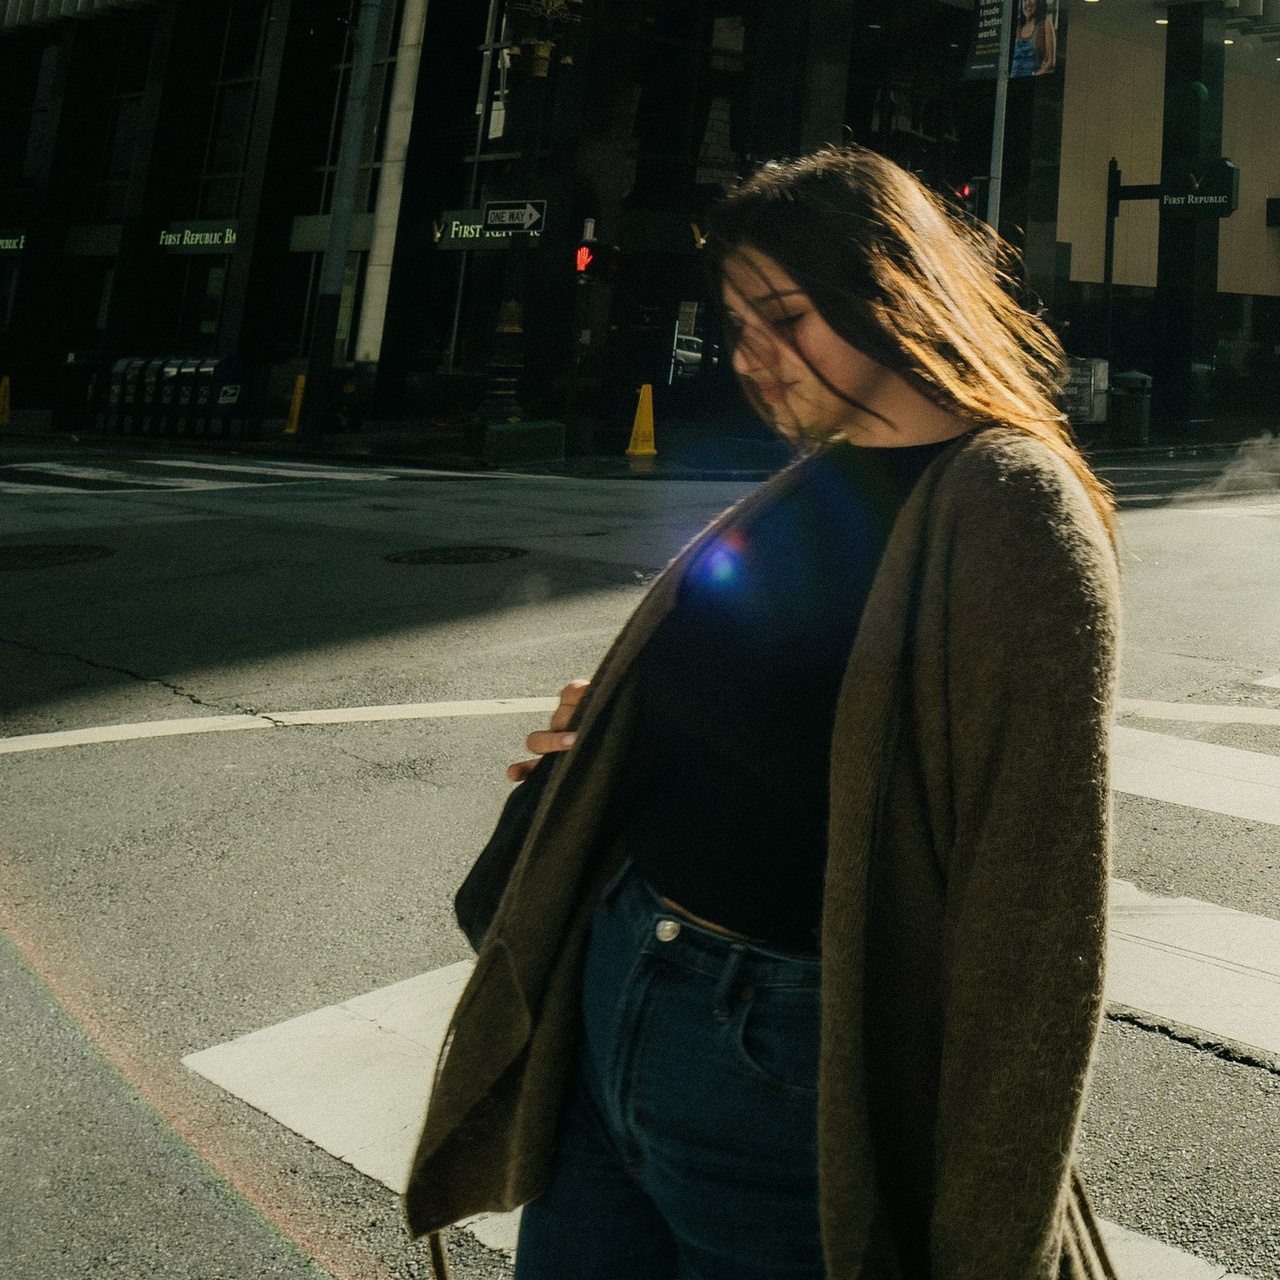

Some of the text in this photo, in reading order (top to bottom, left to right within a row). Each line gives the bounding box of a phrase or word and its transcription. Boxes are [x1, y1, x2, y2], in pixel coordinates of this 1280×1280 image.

[983, 6, 1000, 16] made
[1163, 194, 1228, 205] FIRST REPUBLIC
[490, 211, 526, 223] ONE WAY
[450, 221, 483, 238] FIRST
[159, 230, 182, 246] FIRST
[183, 229, 223, 245] REPUBLIC
